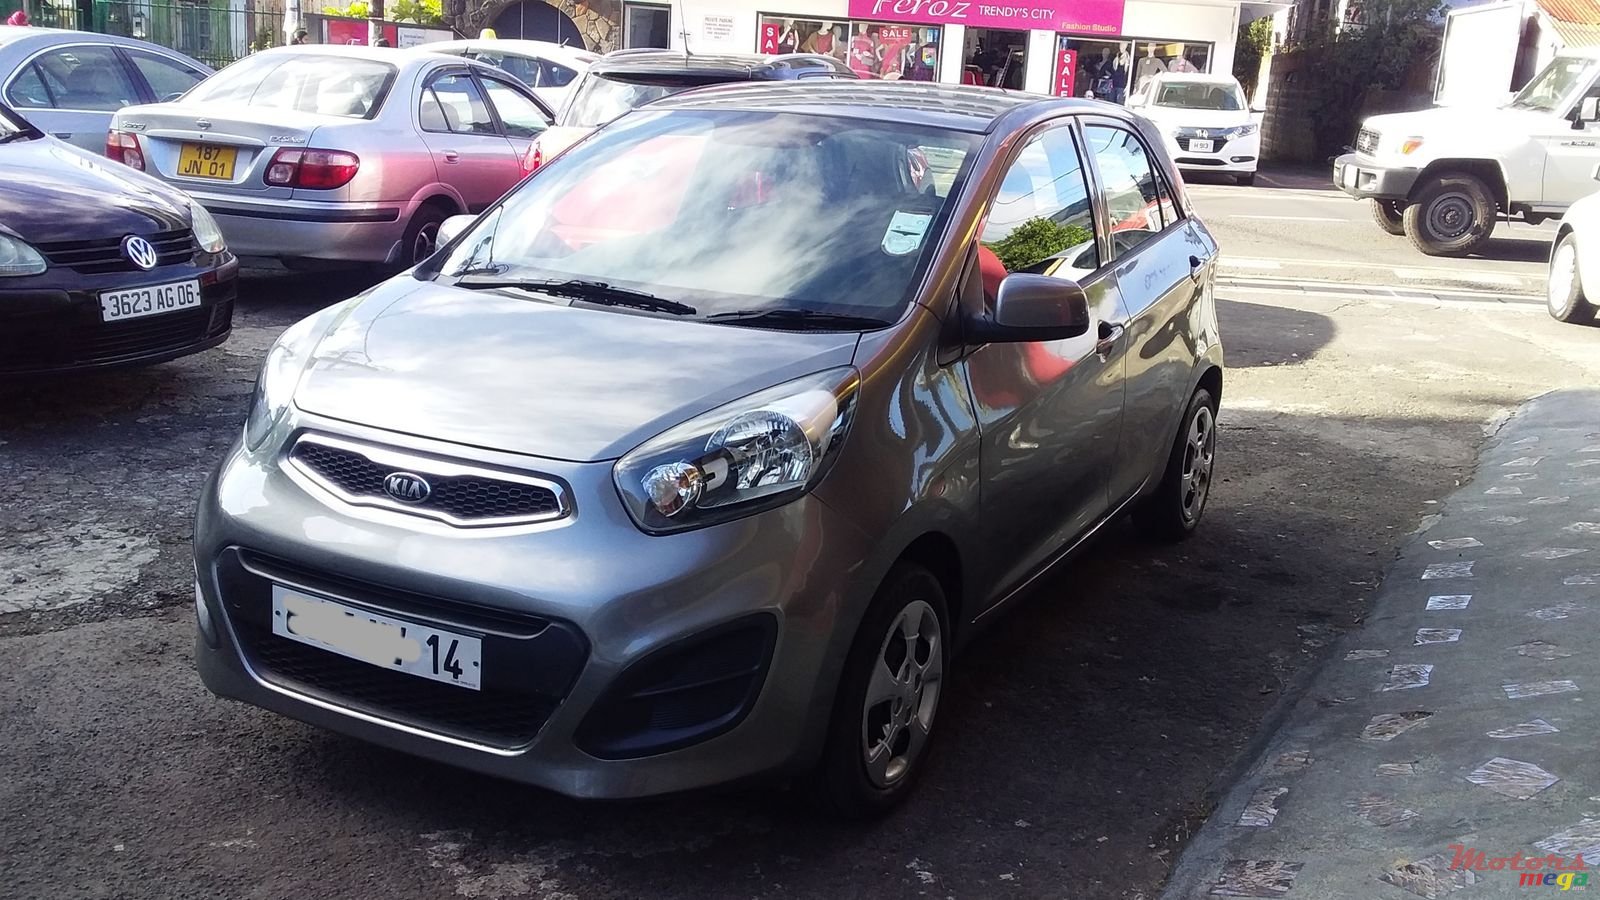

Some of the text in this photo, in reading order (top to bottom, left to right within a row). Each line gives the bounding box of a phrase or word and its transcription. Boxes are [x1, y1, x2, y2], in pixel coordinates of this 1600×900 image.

[872, 0, 1056, 20] Feroz TRENDY'S CITY
[882, 29, 908, 38] SALE
[1061, 22, 1117, 32] Fashion Studio
[765, 27, 775, 55] SA
[196, 147, 221, 160] 187
[184, 161, 226, 176] JN 01
[109, 284, 194, 317] 3623 AG 06
[388, 476, 422, 499] KIA
[426, 634, 463, 679] 14
